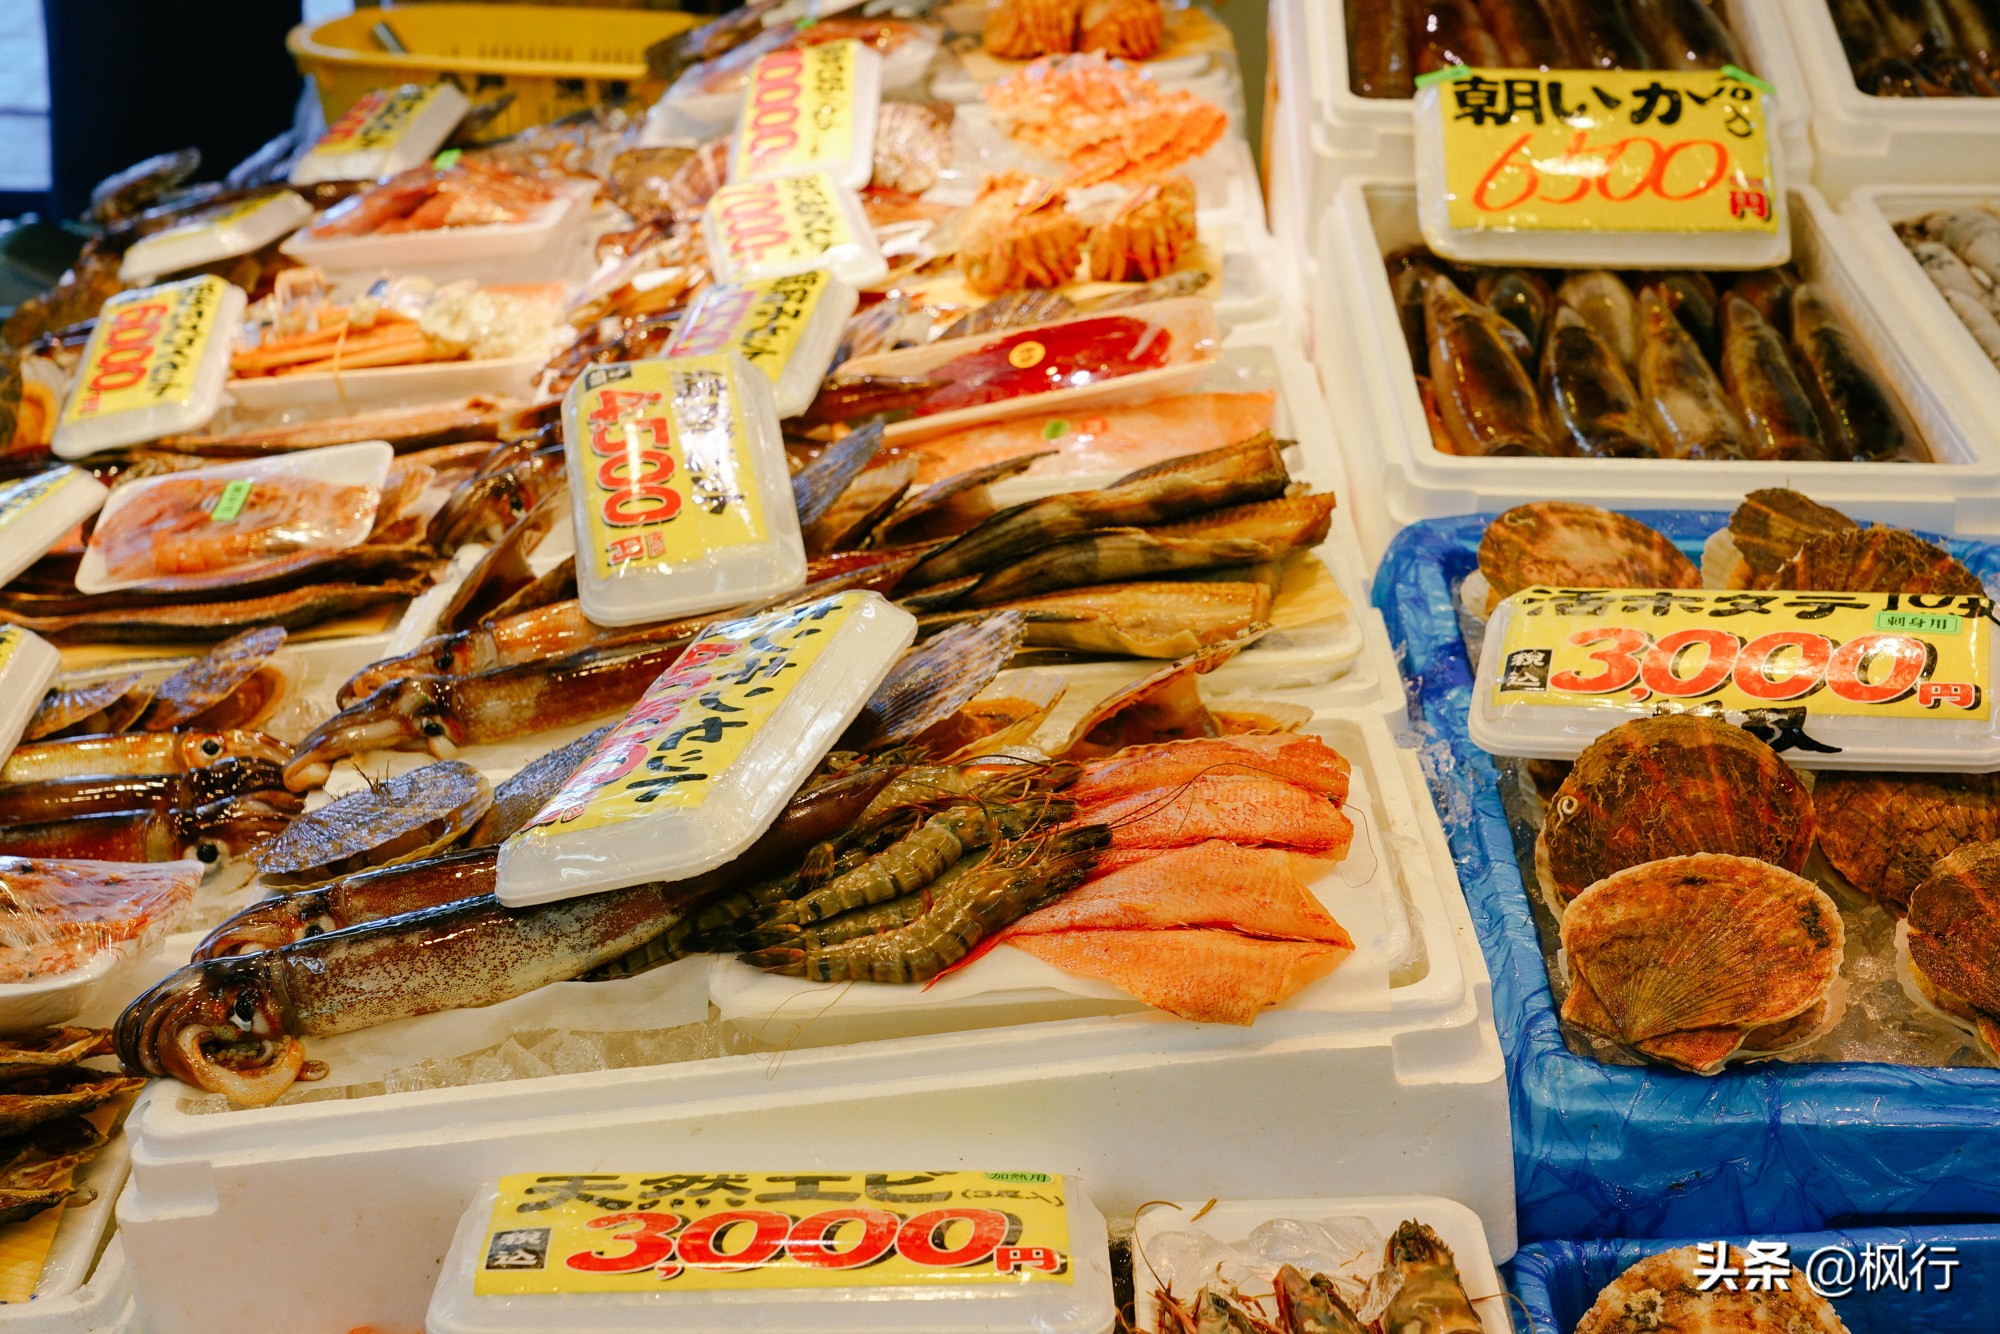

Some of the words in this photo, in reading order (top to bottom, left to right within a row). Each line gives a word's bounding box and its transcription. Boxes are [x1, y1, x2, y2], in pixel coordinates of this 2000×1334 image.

[1887, 616, 1948, 630] 刺身用
[1506, 651, 1545, 687] 税込
[991, 1172, 1046, 1182] 加熱用
[493, 1231, 542, 1266] 税込
